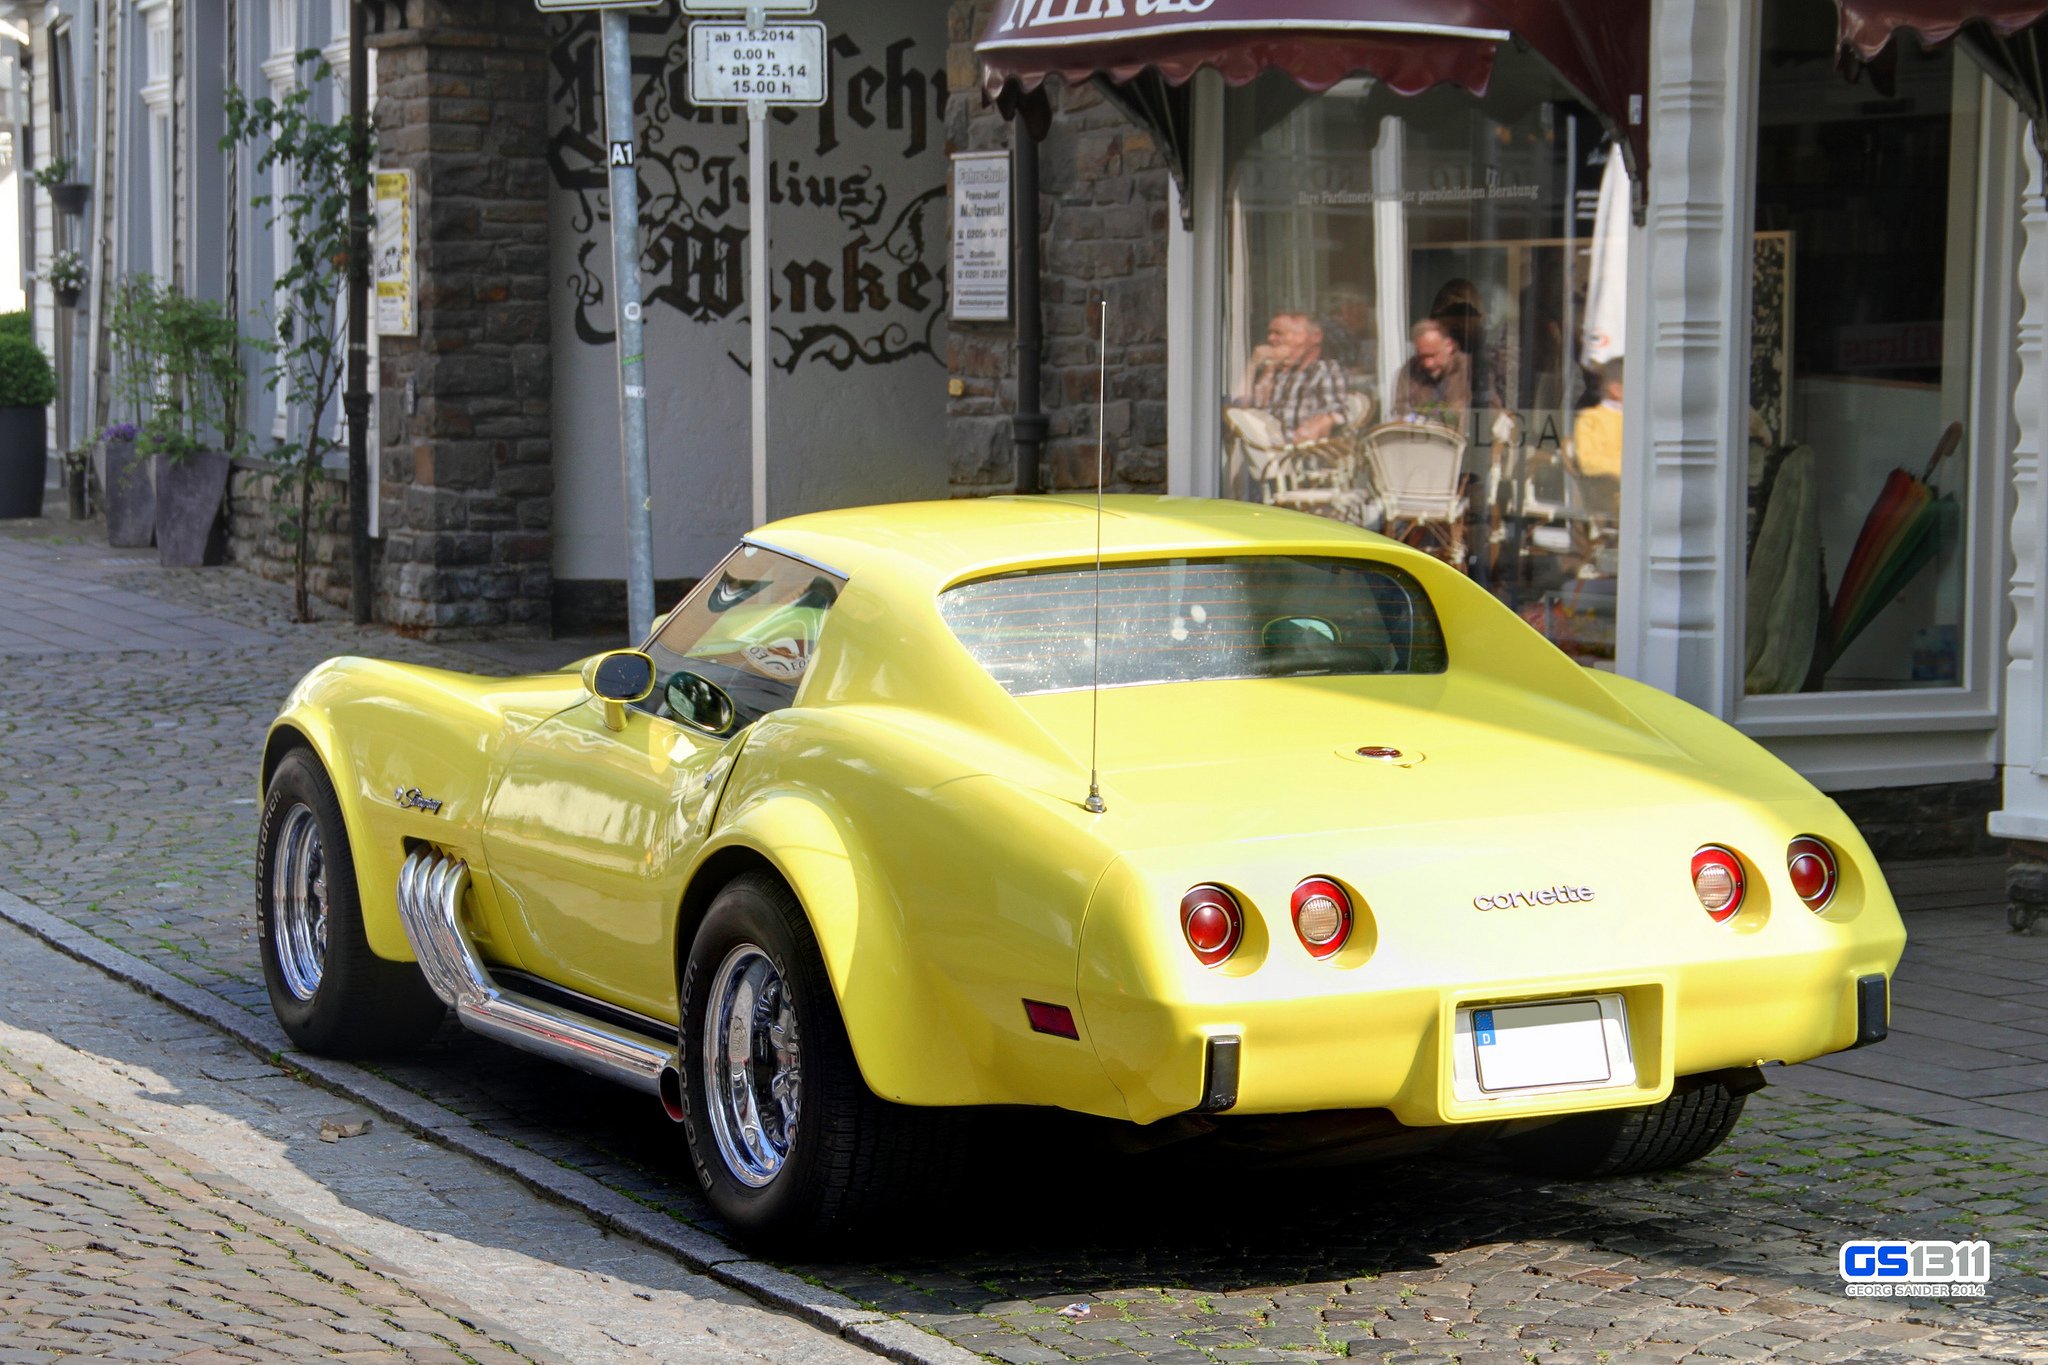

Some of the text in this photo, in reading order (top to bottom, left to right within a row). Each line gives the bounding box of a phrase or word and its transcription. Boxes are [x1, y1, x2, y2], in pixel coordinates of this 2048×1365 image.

[715, 30, 795, 42] ab 1.5.2014
[733, 49, 776, 60] 0.00 h
[732, 64, 751, 76] ab
[757, 64, 807, 77] 2.5.14
[733, 81, 792, 94] 15.00 h
[611, 143, 634, 165] A1
[1474, 886, 1595, 911] corvette
[1482, 1033, 1491, 1045] D
